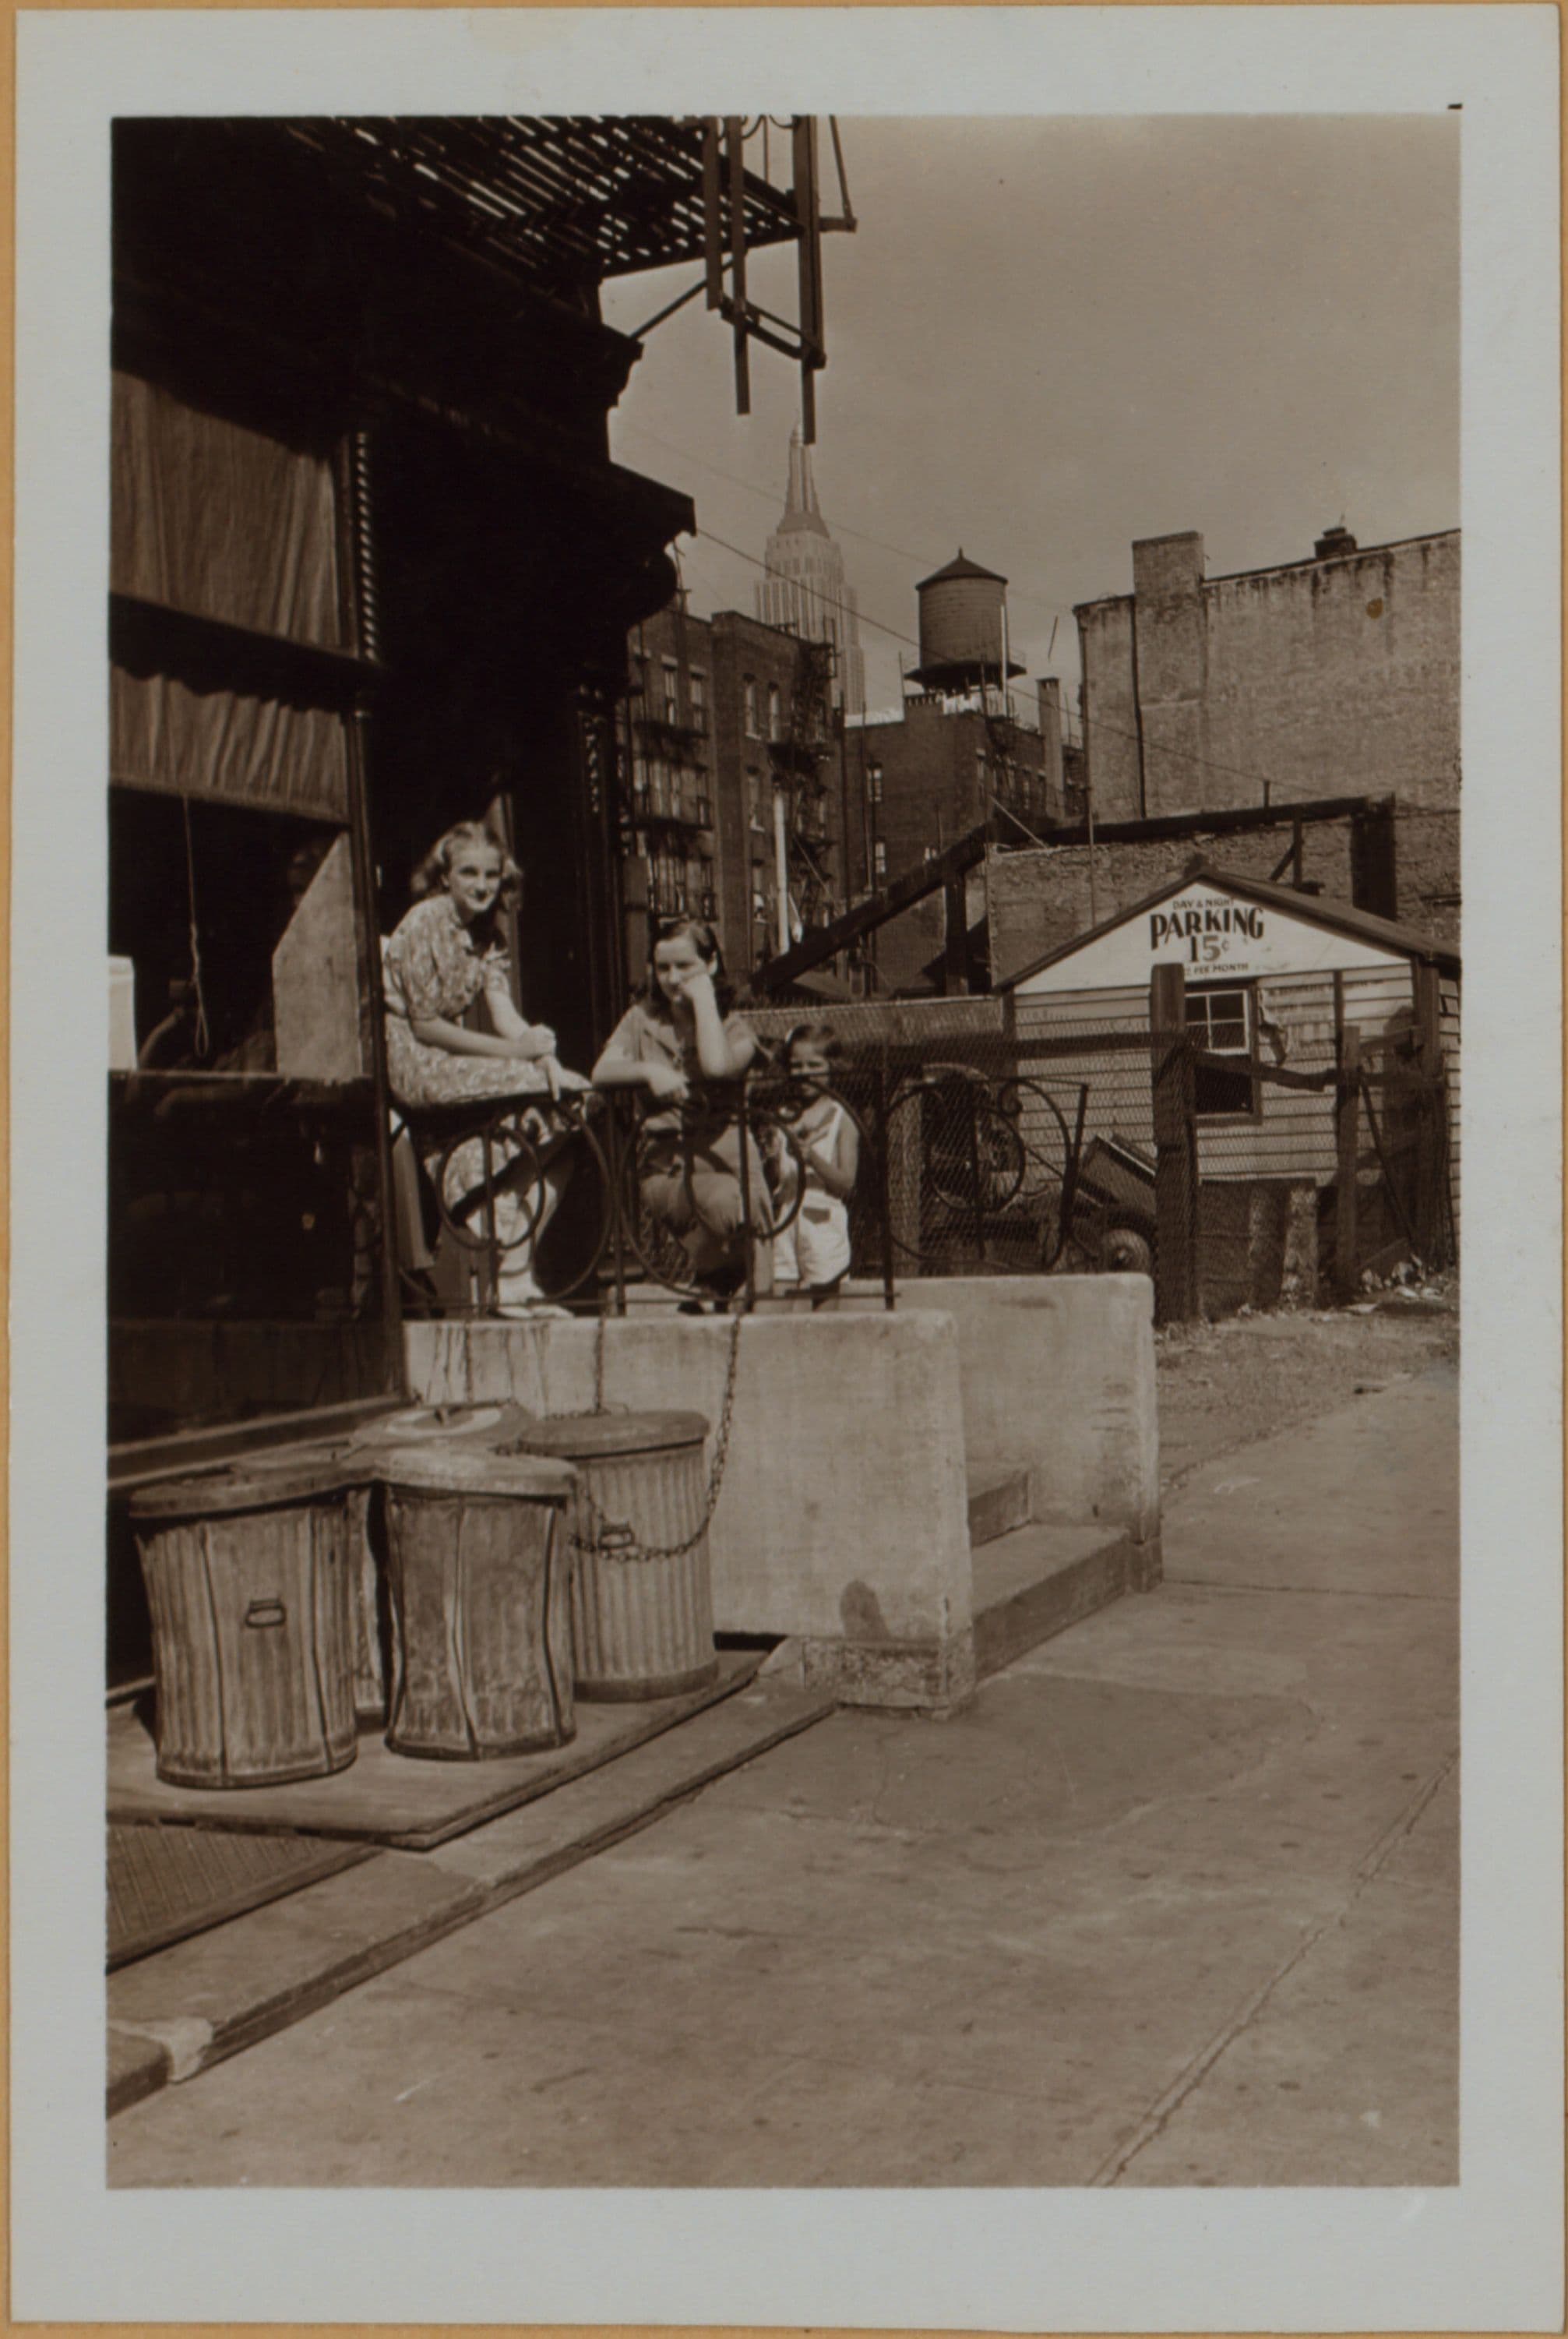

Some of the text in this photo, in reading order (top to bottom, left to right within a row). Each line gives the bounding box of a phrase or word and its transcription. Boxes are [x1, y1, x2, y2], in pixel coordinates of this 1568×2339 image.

[1172, 899, 1194, 910] DAY
[1196, 900, 1203, 908] &
[1150, 907, 1264, 951] PARKING
[1213, 962, 1249, 972] MONTH
